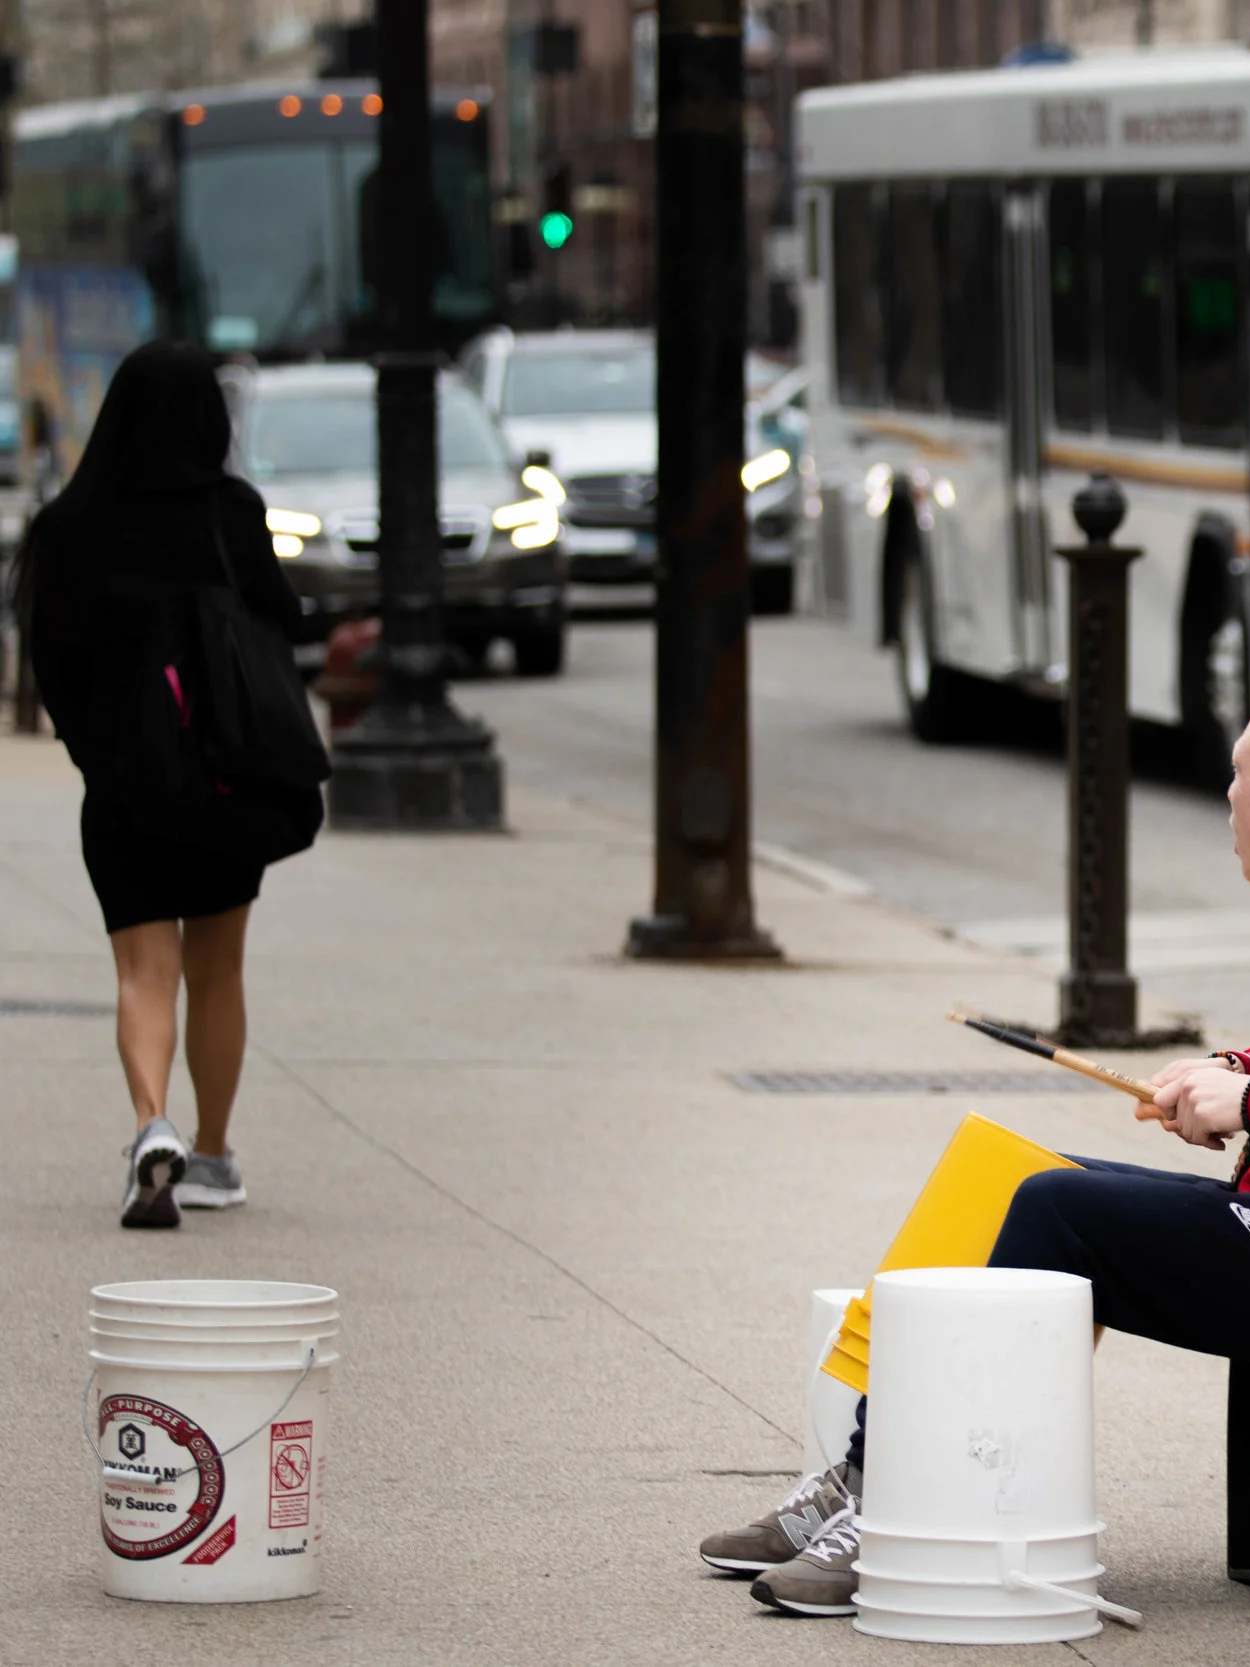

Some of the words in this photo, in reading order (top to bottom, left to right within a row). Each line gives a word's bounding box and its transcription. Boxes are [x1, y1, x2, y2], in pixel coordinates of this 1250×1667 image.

[104, 1492, 122, 1510] Soy
[126, 1496, 178, 1513] Sauce
[778, 1503, 825, 1550] N
